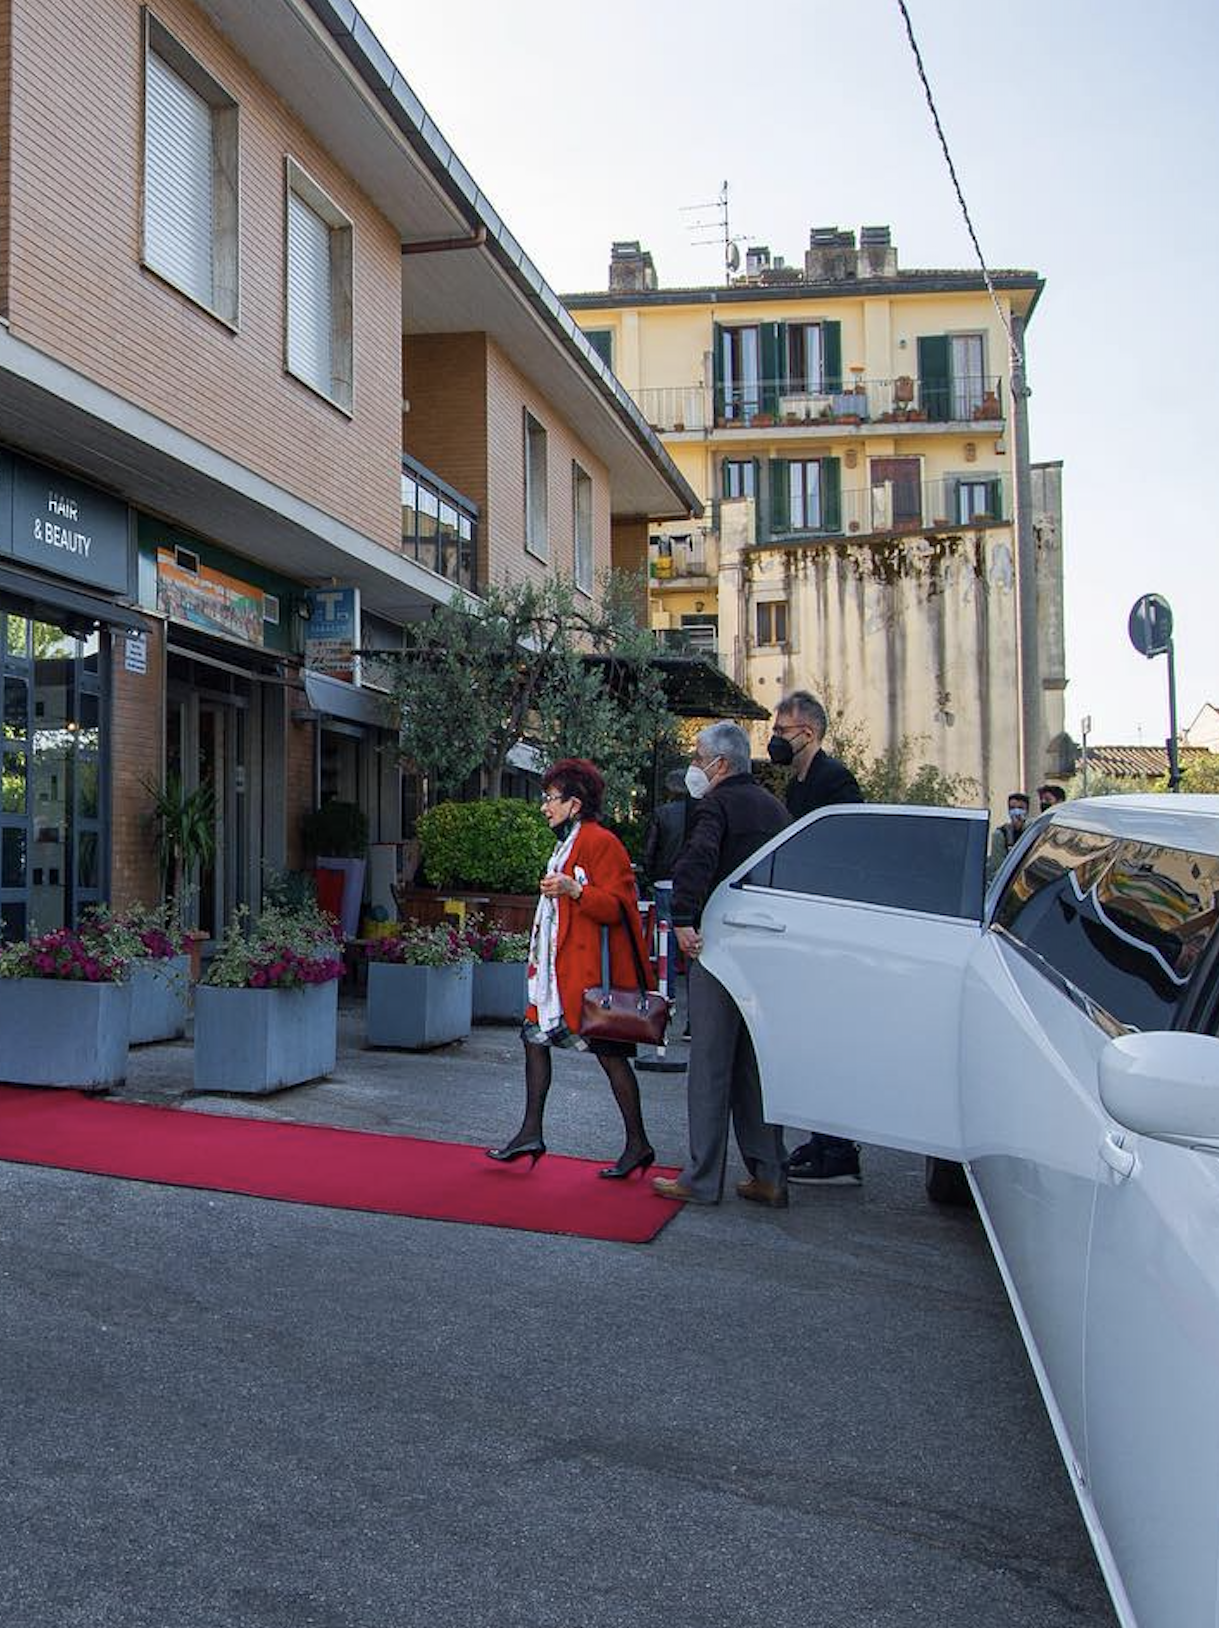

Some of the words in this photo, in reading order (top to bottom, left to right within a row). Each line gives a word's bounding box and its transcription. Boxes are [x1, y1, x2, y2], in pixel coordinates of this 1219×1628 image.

[48, 491, 78, 521] HAIR
[34, 518, 43, 541] &
[45, 522, 91, 557] BEAUTY
